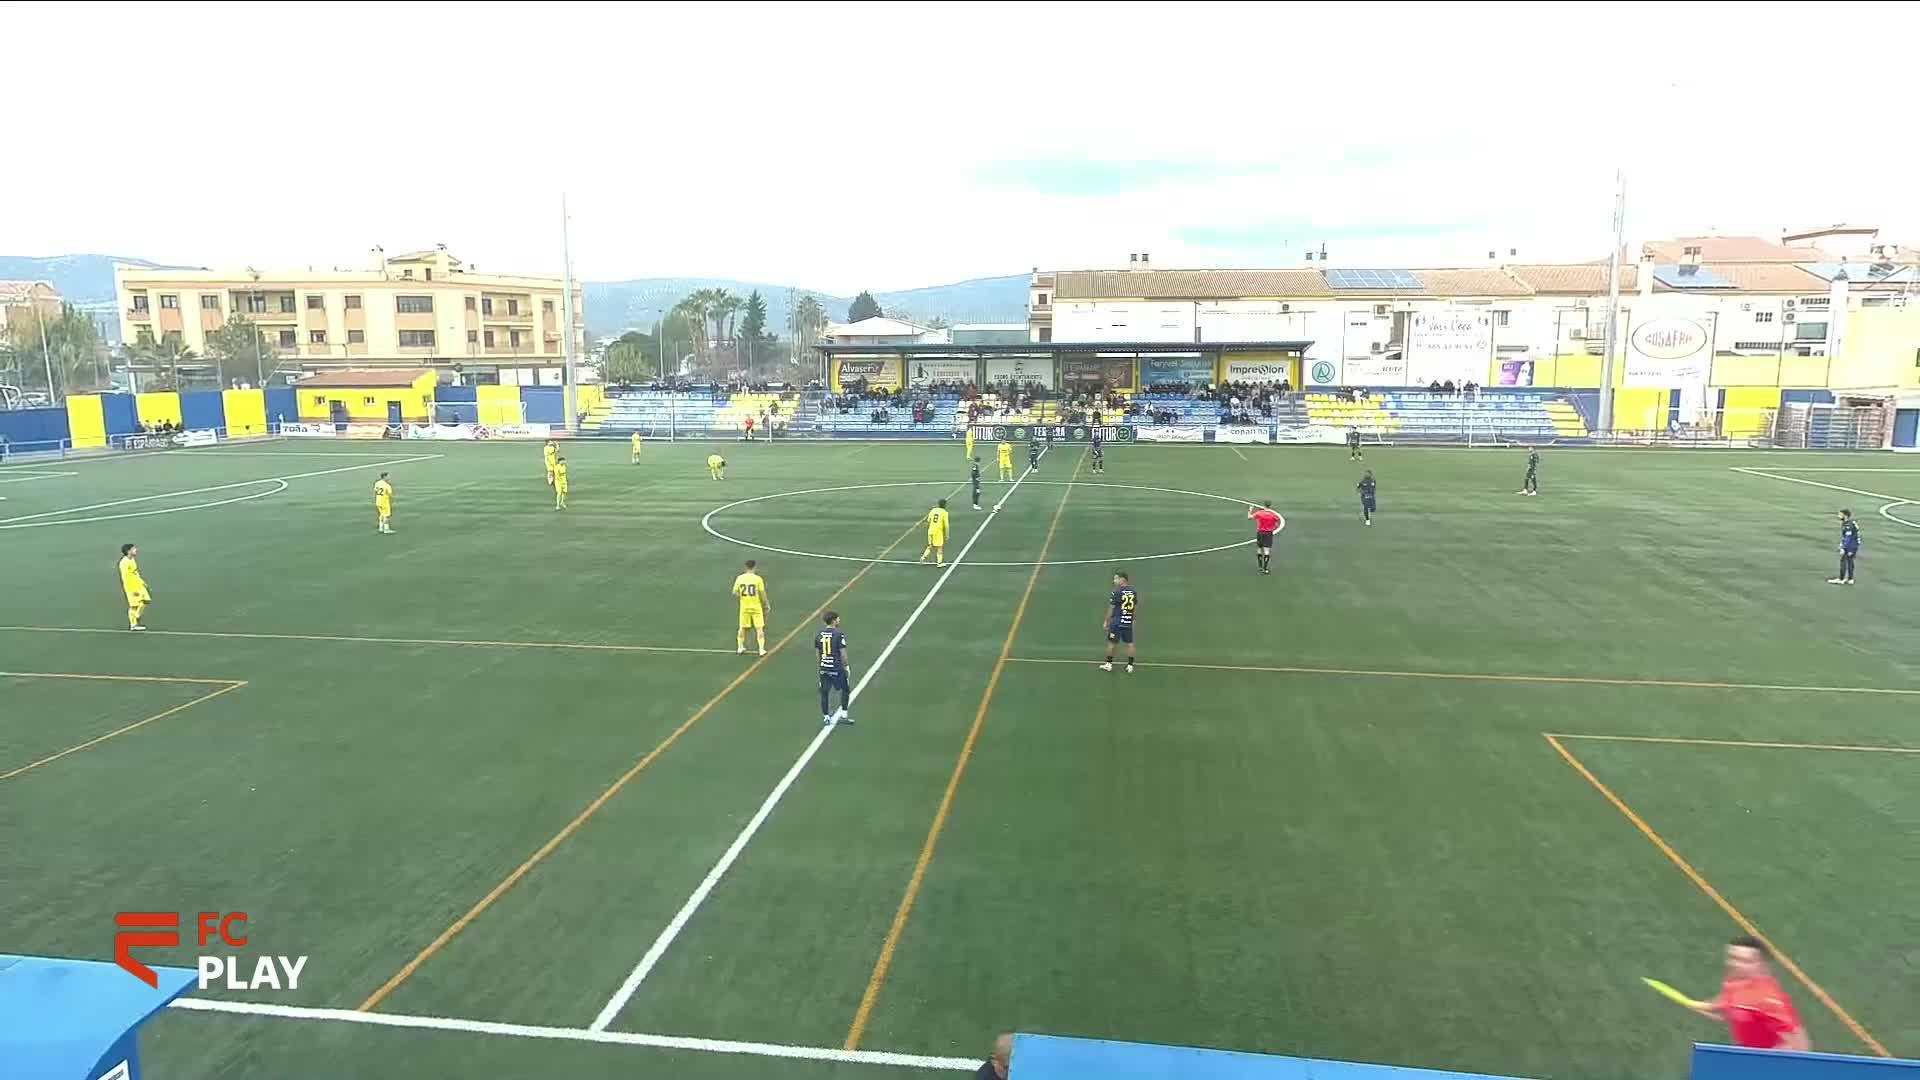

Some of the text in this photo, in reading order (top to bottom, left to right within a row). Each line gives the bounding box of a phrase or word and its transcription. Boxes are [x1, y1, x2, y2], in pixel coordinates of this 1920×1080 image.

[740, 583, 757, 597] 20
[1121, 594, 1135, 611] 23
[820, 637, 832, 656] 11
